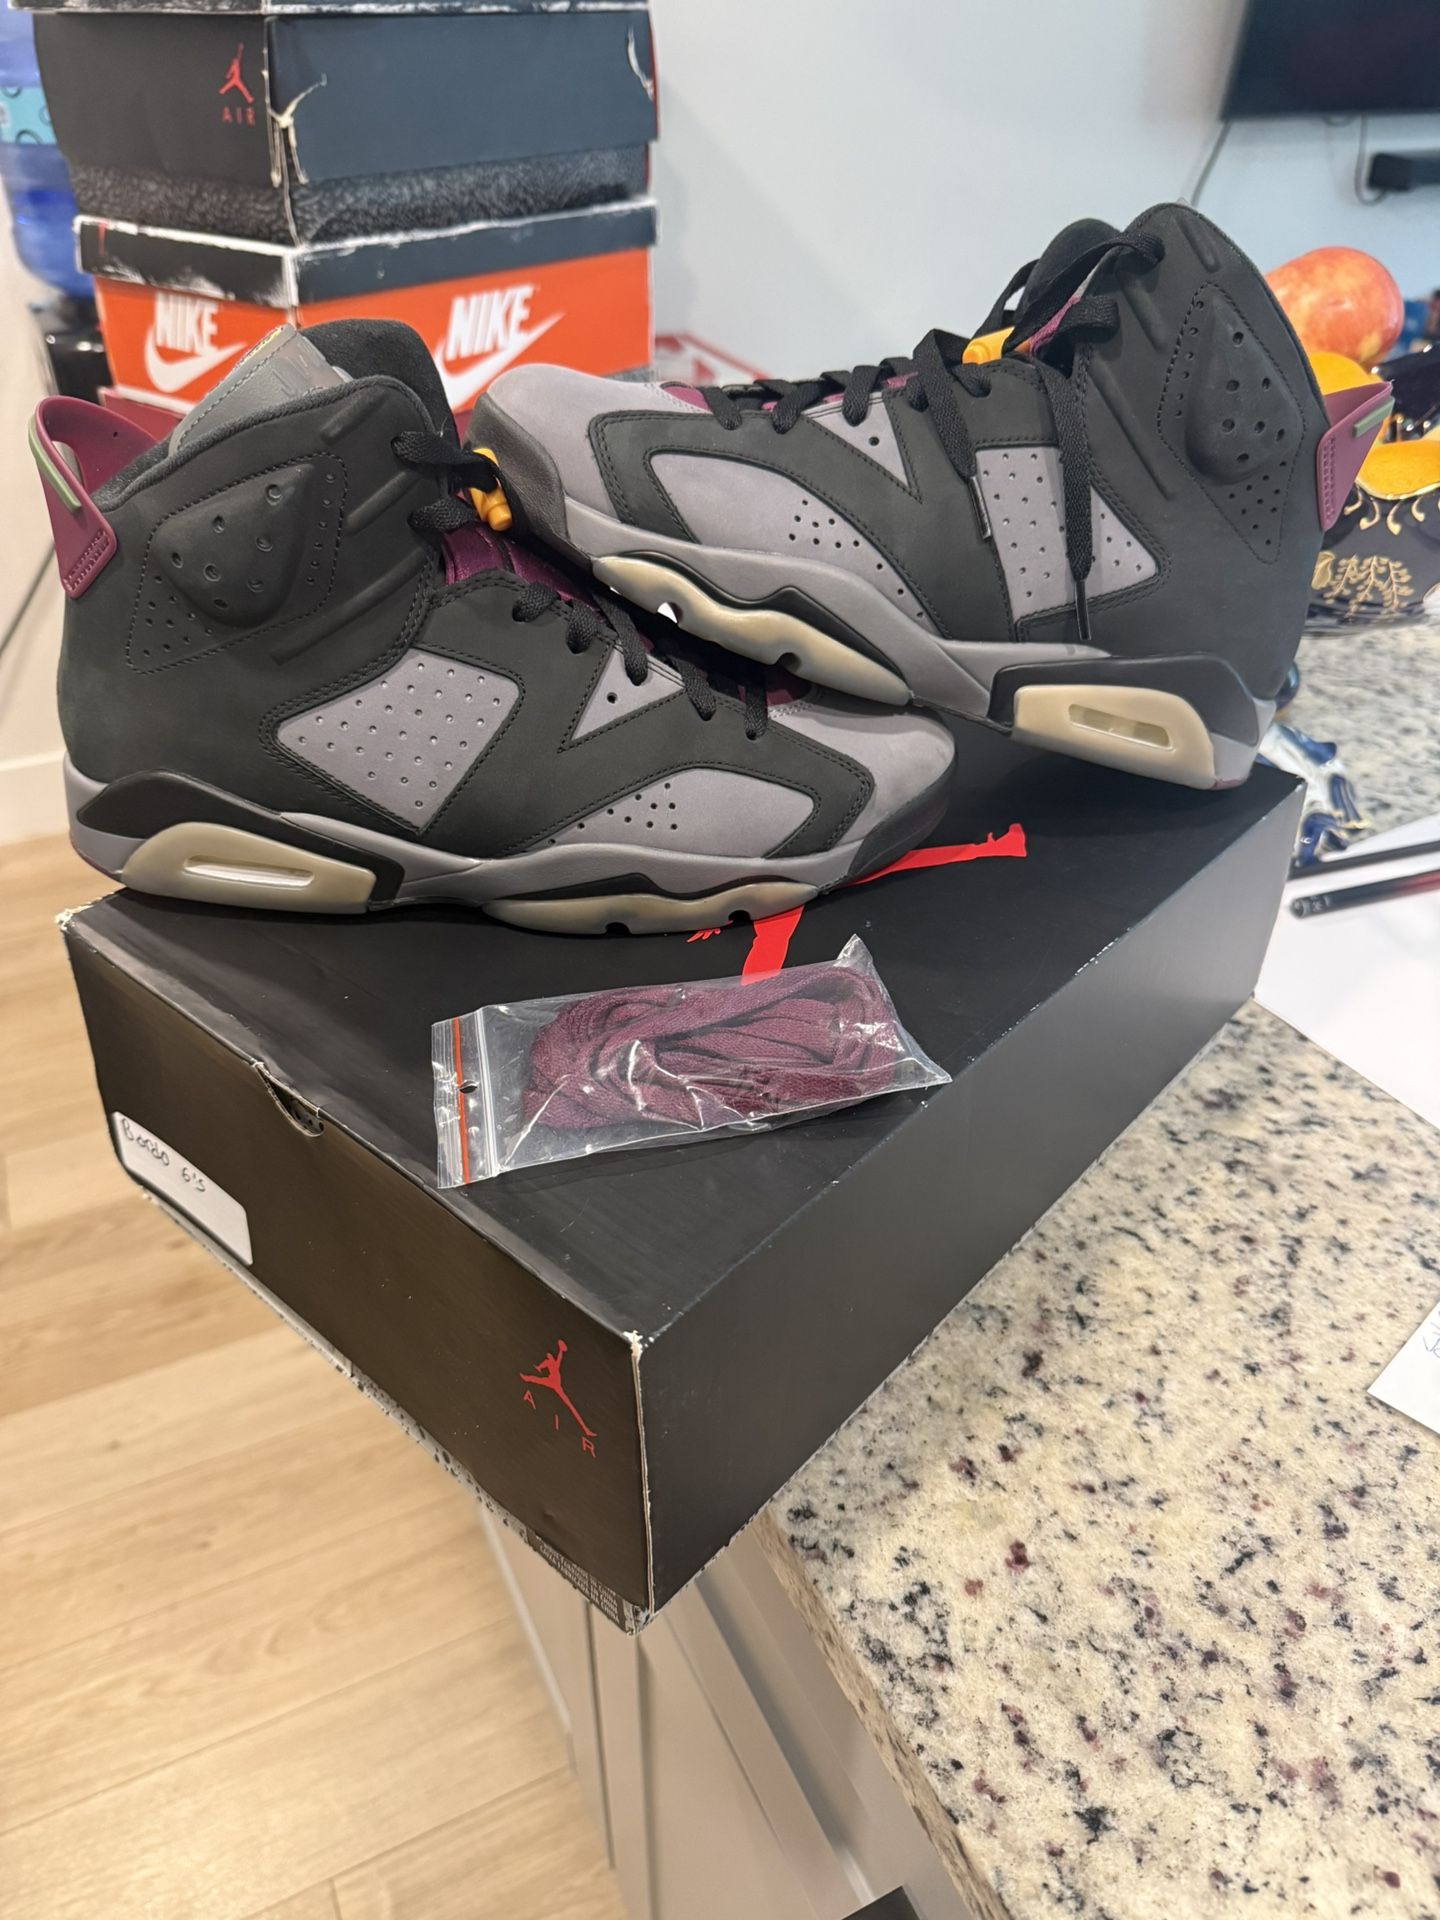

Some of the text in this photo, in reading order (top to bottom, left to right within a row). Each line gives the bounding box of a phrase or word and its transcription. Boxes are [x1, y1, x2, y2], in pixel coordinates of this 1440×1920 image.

[222, 106, 255, 127] AIR
[155, 291, 219, 355] NIKE
[445, 283, 535, 361] NIKE
[523, 1389, 597, 1459] AIR
